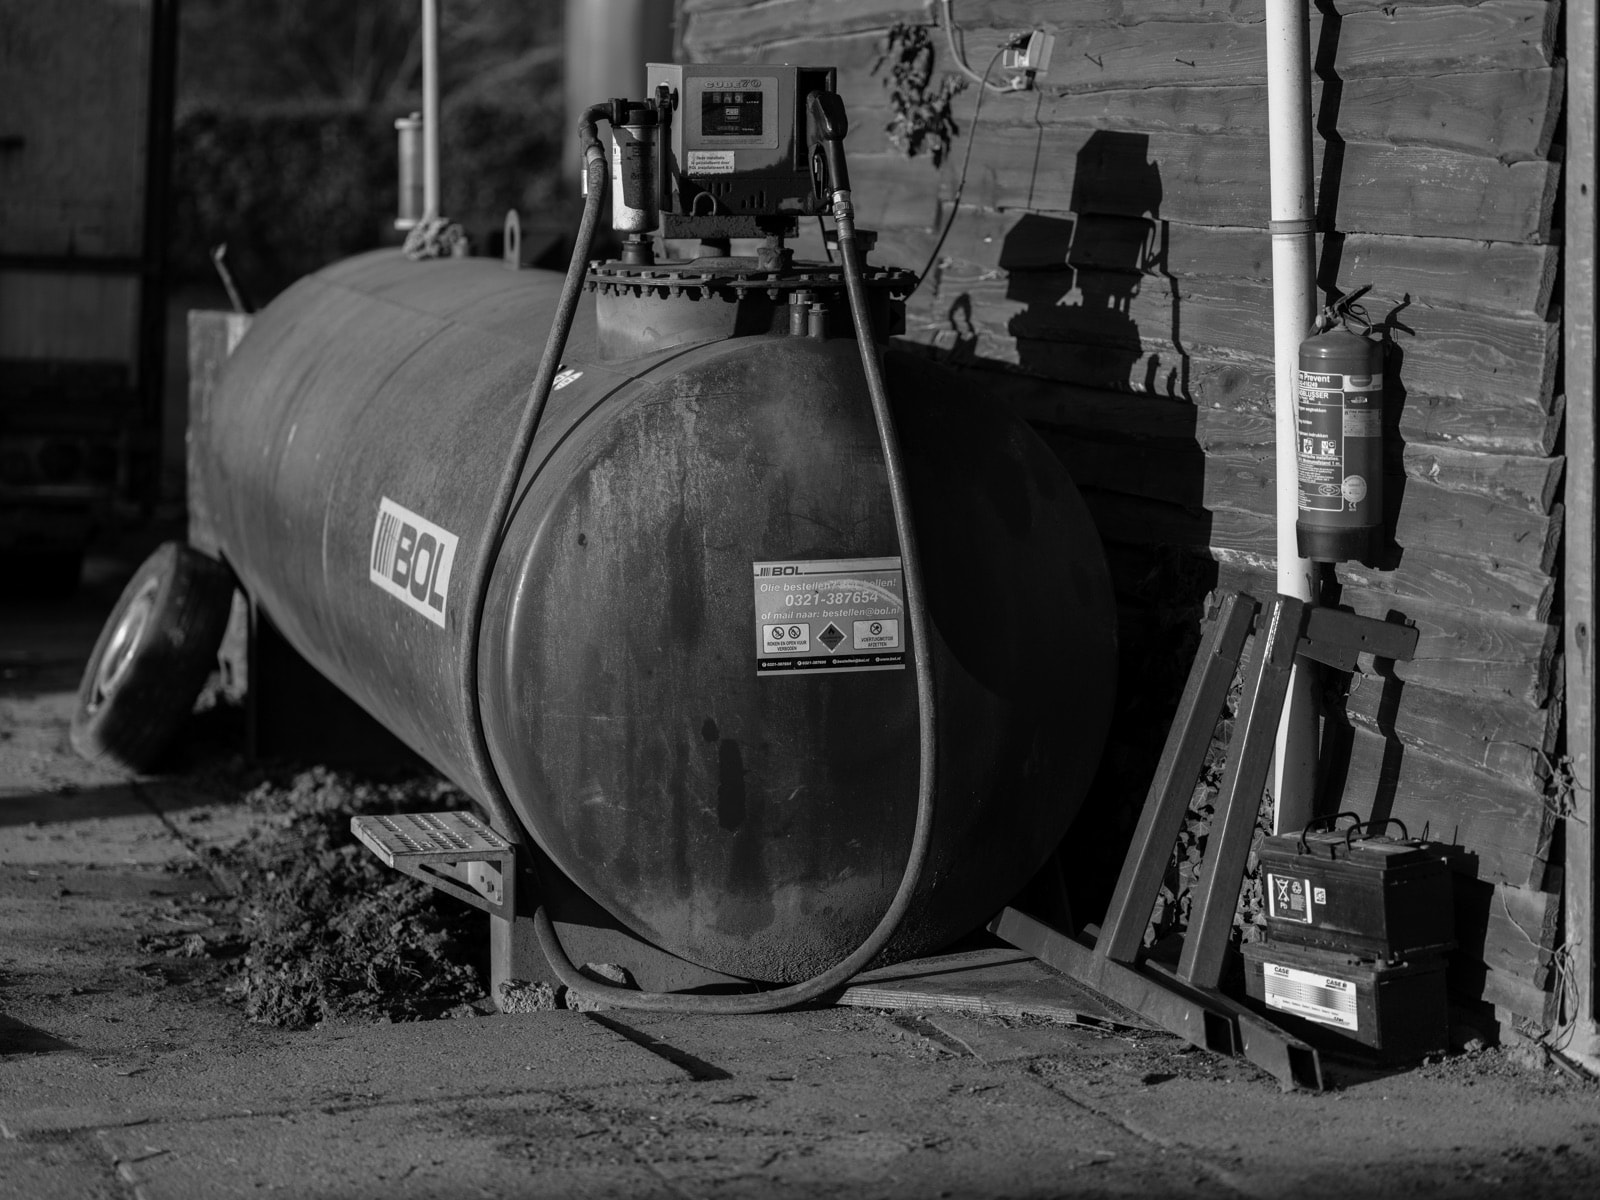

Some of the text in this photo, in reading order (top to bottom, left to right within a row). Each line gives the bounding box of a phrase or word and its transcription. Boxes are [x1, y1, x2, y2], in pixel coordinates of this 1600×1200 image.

[1304, 374, 1330, 383] Prevent
[392, 522, 446, 613] BOL
[772, 566, 803, 576] BOL
[760, 583, 780, 592] Olie
[786, 591, 879, 606] 0321-387654
[761, 607, 900, 620] of mail naar: bestellen@bol.nl
[1274, 966, 1289, 975] CASE
[1326, 979, 1341, 987] CASE
